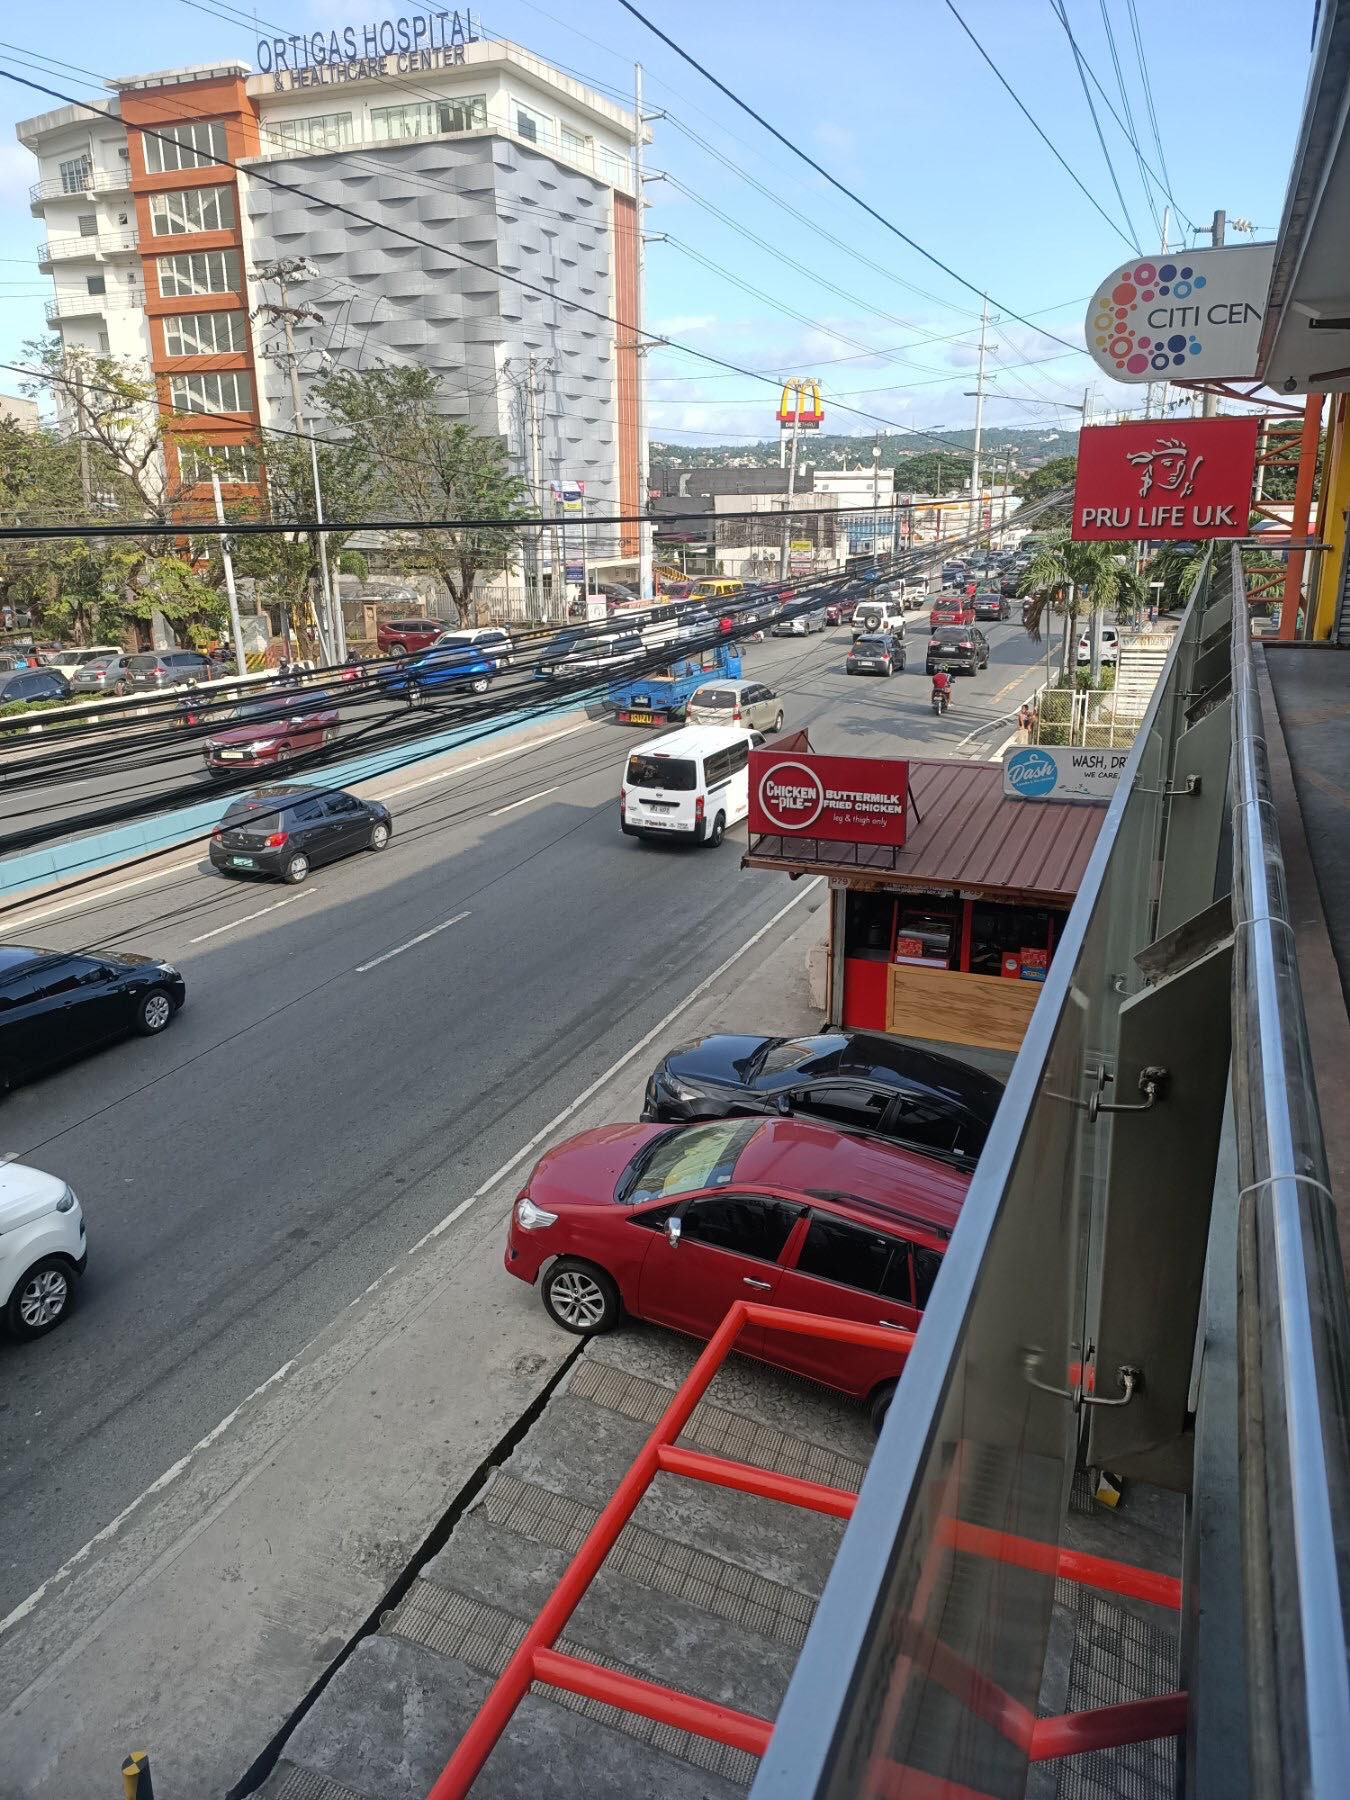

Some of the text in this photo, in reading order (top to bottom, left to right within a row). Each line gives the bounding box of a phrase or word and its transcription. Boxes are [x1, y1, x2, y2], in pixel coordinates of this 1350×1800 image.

[257, 8, 479, 73] ORTIGAS HOSPITAL
[274, 44, 466, 92] & HEALTHCARE CENTER
[1147, 306, 1201, 329] CITI
[1081, 504, 1238, 528] PRU LIFE U.K.
[630, 713, 653, 724] ISUZU
[1072, 755, 1128, 770] WASH, DR
[1008, 763, 1056, 785] Dash
[1084, 771, 1096, 779] WE
[766, 780, 817, 800] CHICKEN
[825, 789, 900, 804] BUTTERMILK
[823, 800, 902, 814] FRIED CHICKEN
[832, 814, 887, 828] leg & thigh only
